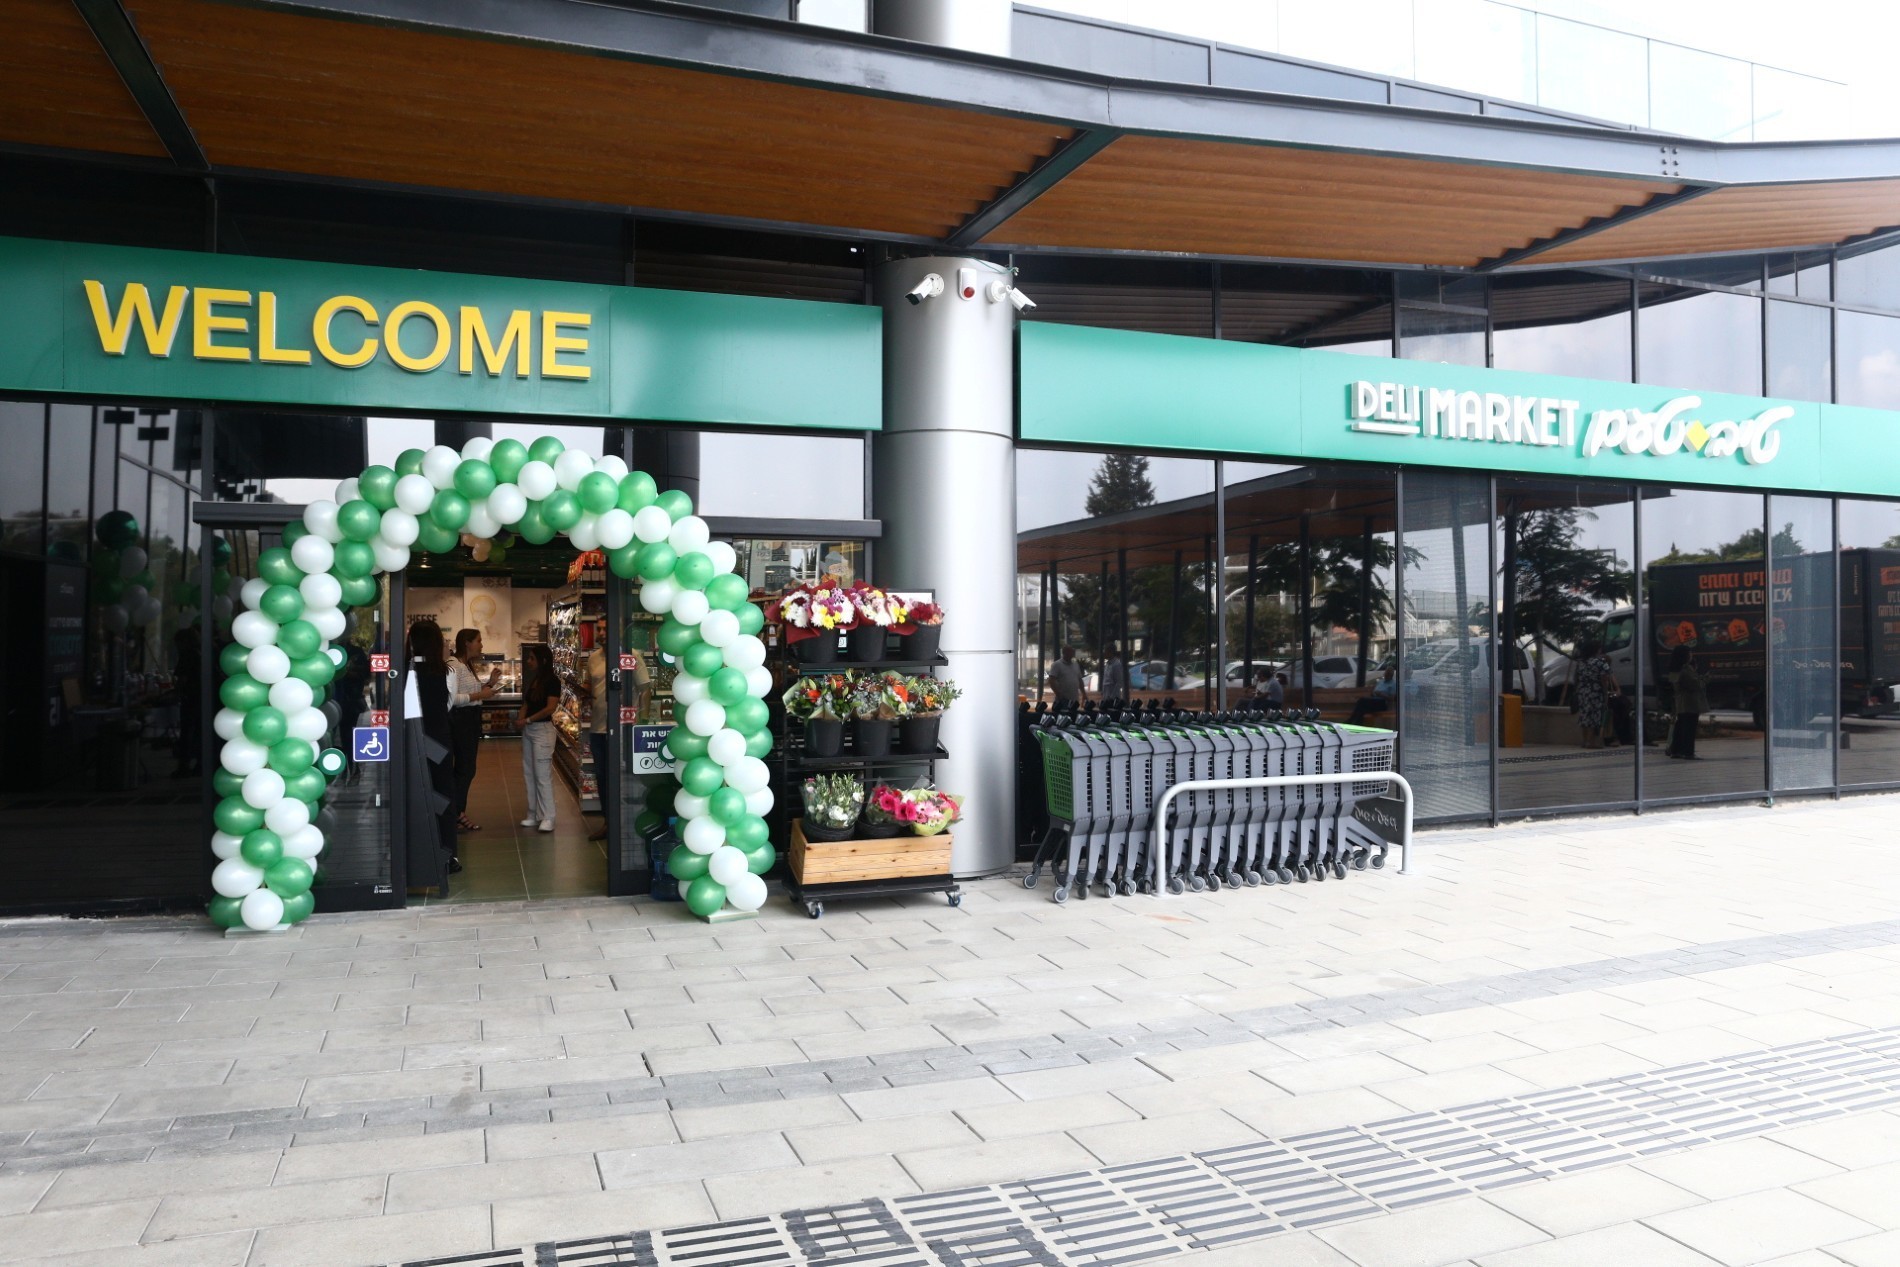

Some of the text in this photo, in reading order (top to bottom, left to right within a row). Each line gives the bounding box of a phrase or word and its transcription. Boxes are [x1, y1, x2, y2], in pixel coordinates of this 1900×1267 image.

[83, 279, 592, 380] WELCOME
[1351, 380, 1580, 446] DELI MARKET
[1583, 395, 1796, 465] טיב טעם
[641, 730, 657, 738] את
